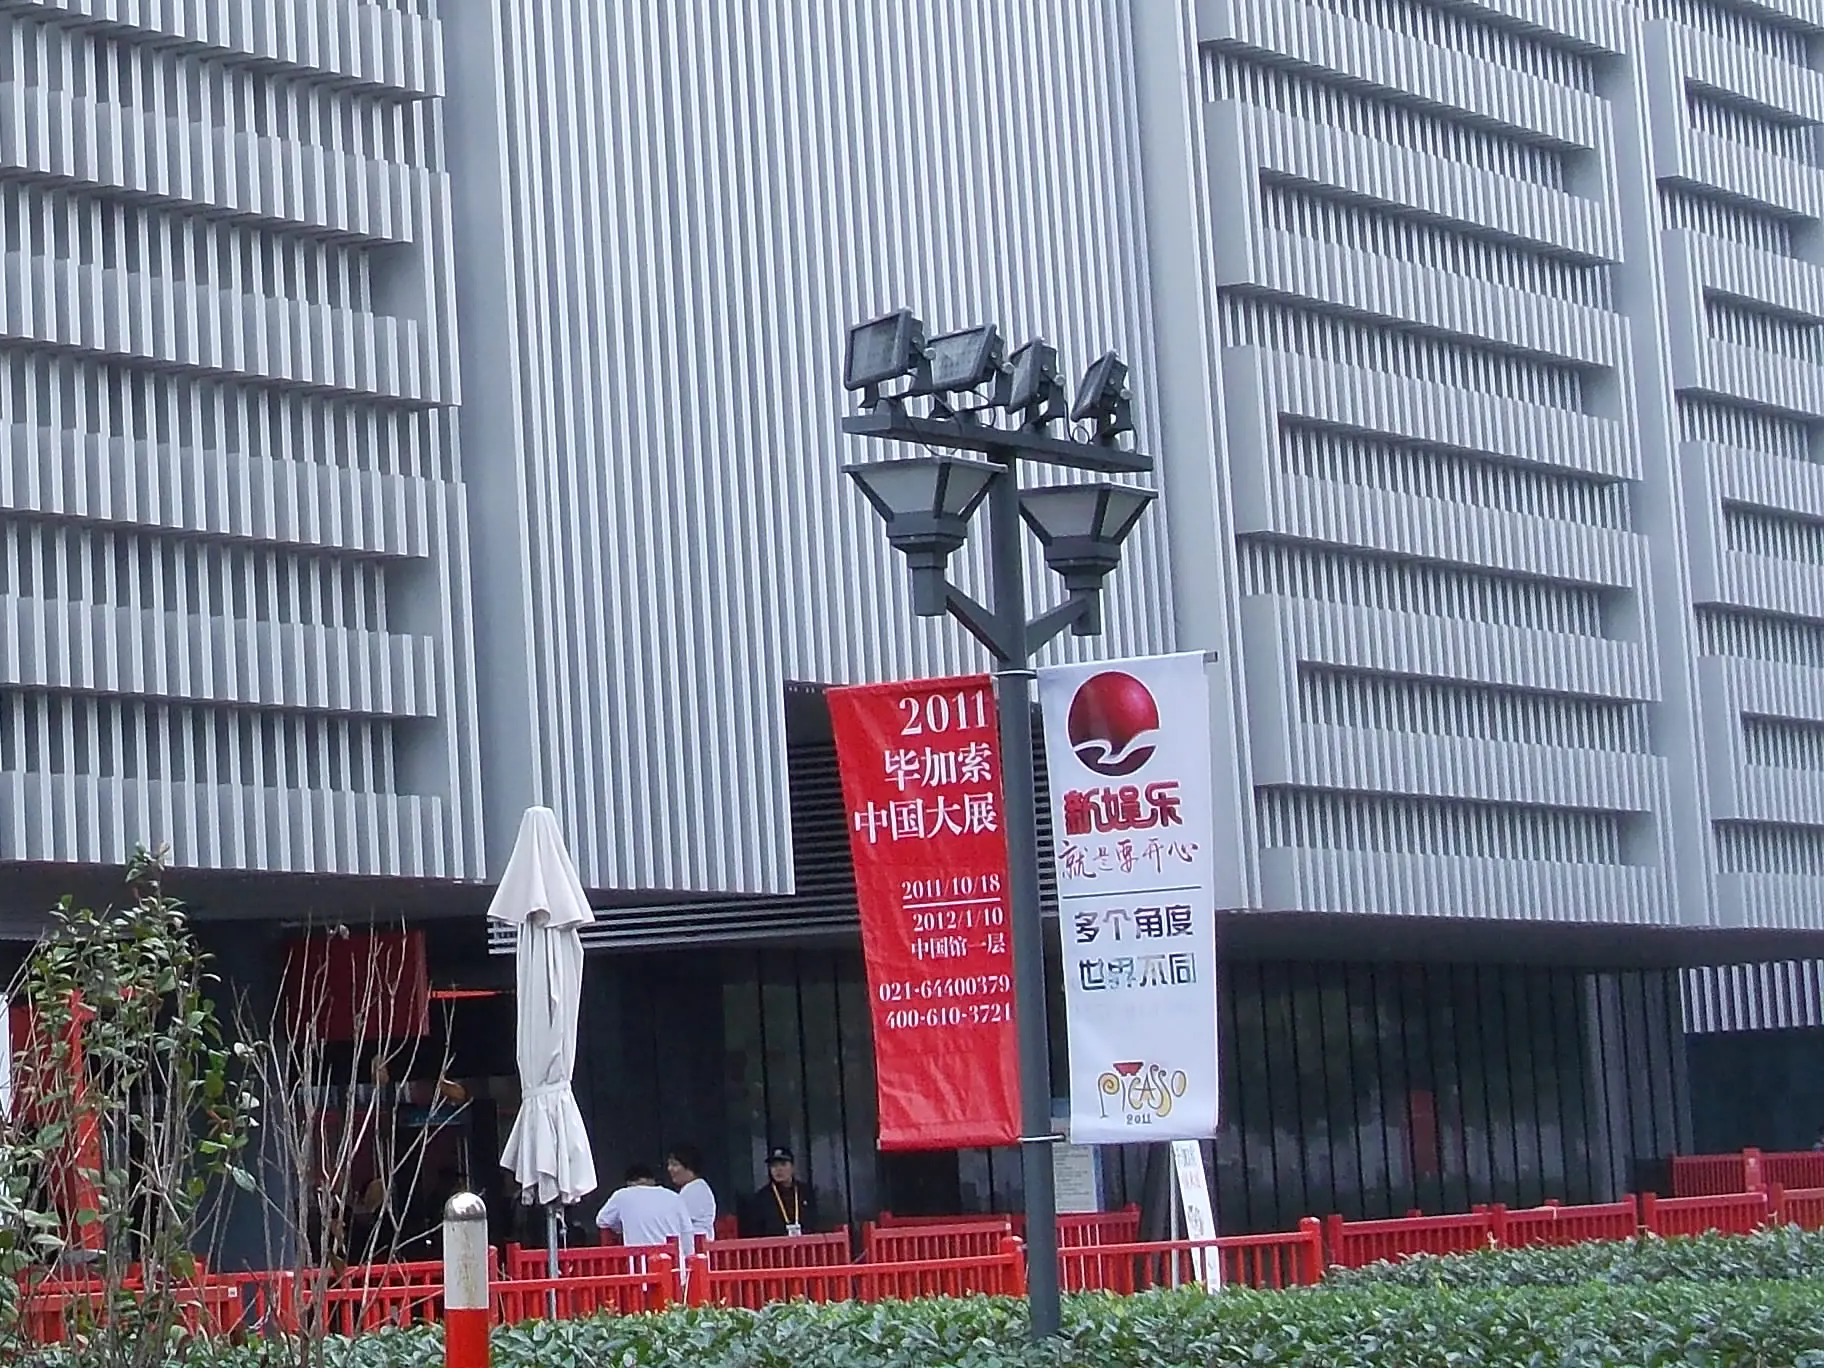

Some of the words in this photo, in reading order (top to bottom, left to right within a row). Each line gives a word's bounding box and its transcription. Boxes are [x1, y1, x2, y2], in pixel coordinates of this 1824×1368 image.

[899, 690, 989, 736] 2011
[884, 742, 993, 792] 毕加索
[854, 792, 998, 844] 中国大展
[1063, 780, 1183, 836] 新娱乐
[1058, 838, 1199, 881] 就是要开心
[901, 873, 1001, 900] 2011/10/18
[913, 907, 1004, 932] 2012/1/10
[1074, 904, 1194, 944] 多个角度
[911, 932, 1006, 961] 中国馆一层
[879, 974, 1011, 1002] 021-64400379
[1078, 952, 1198, 991] 世界不同
[885, 1002, 1011, 1029] 400-610-3721
[1125, 1113, 1153, 1125] 2011
